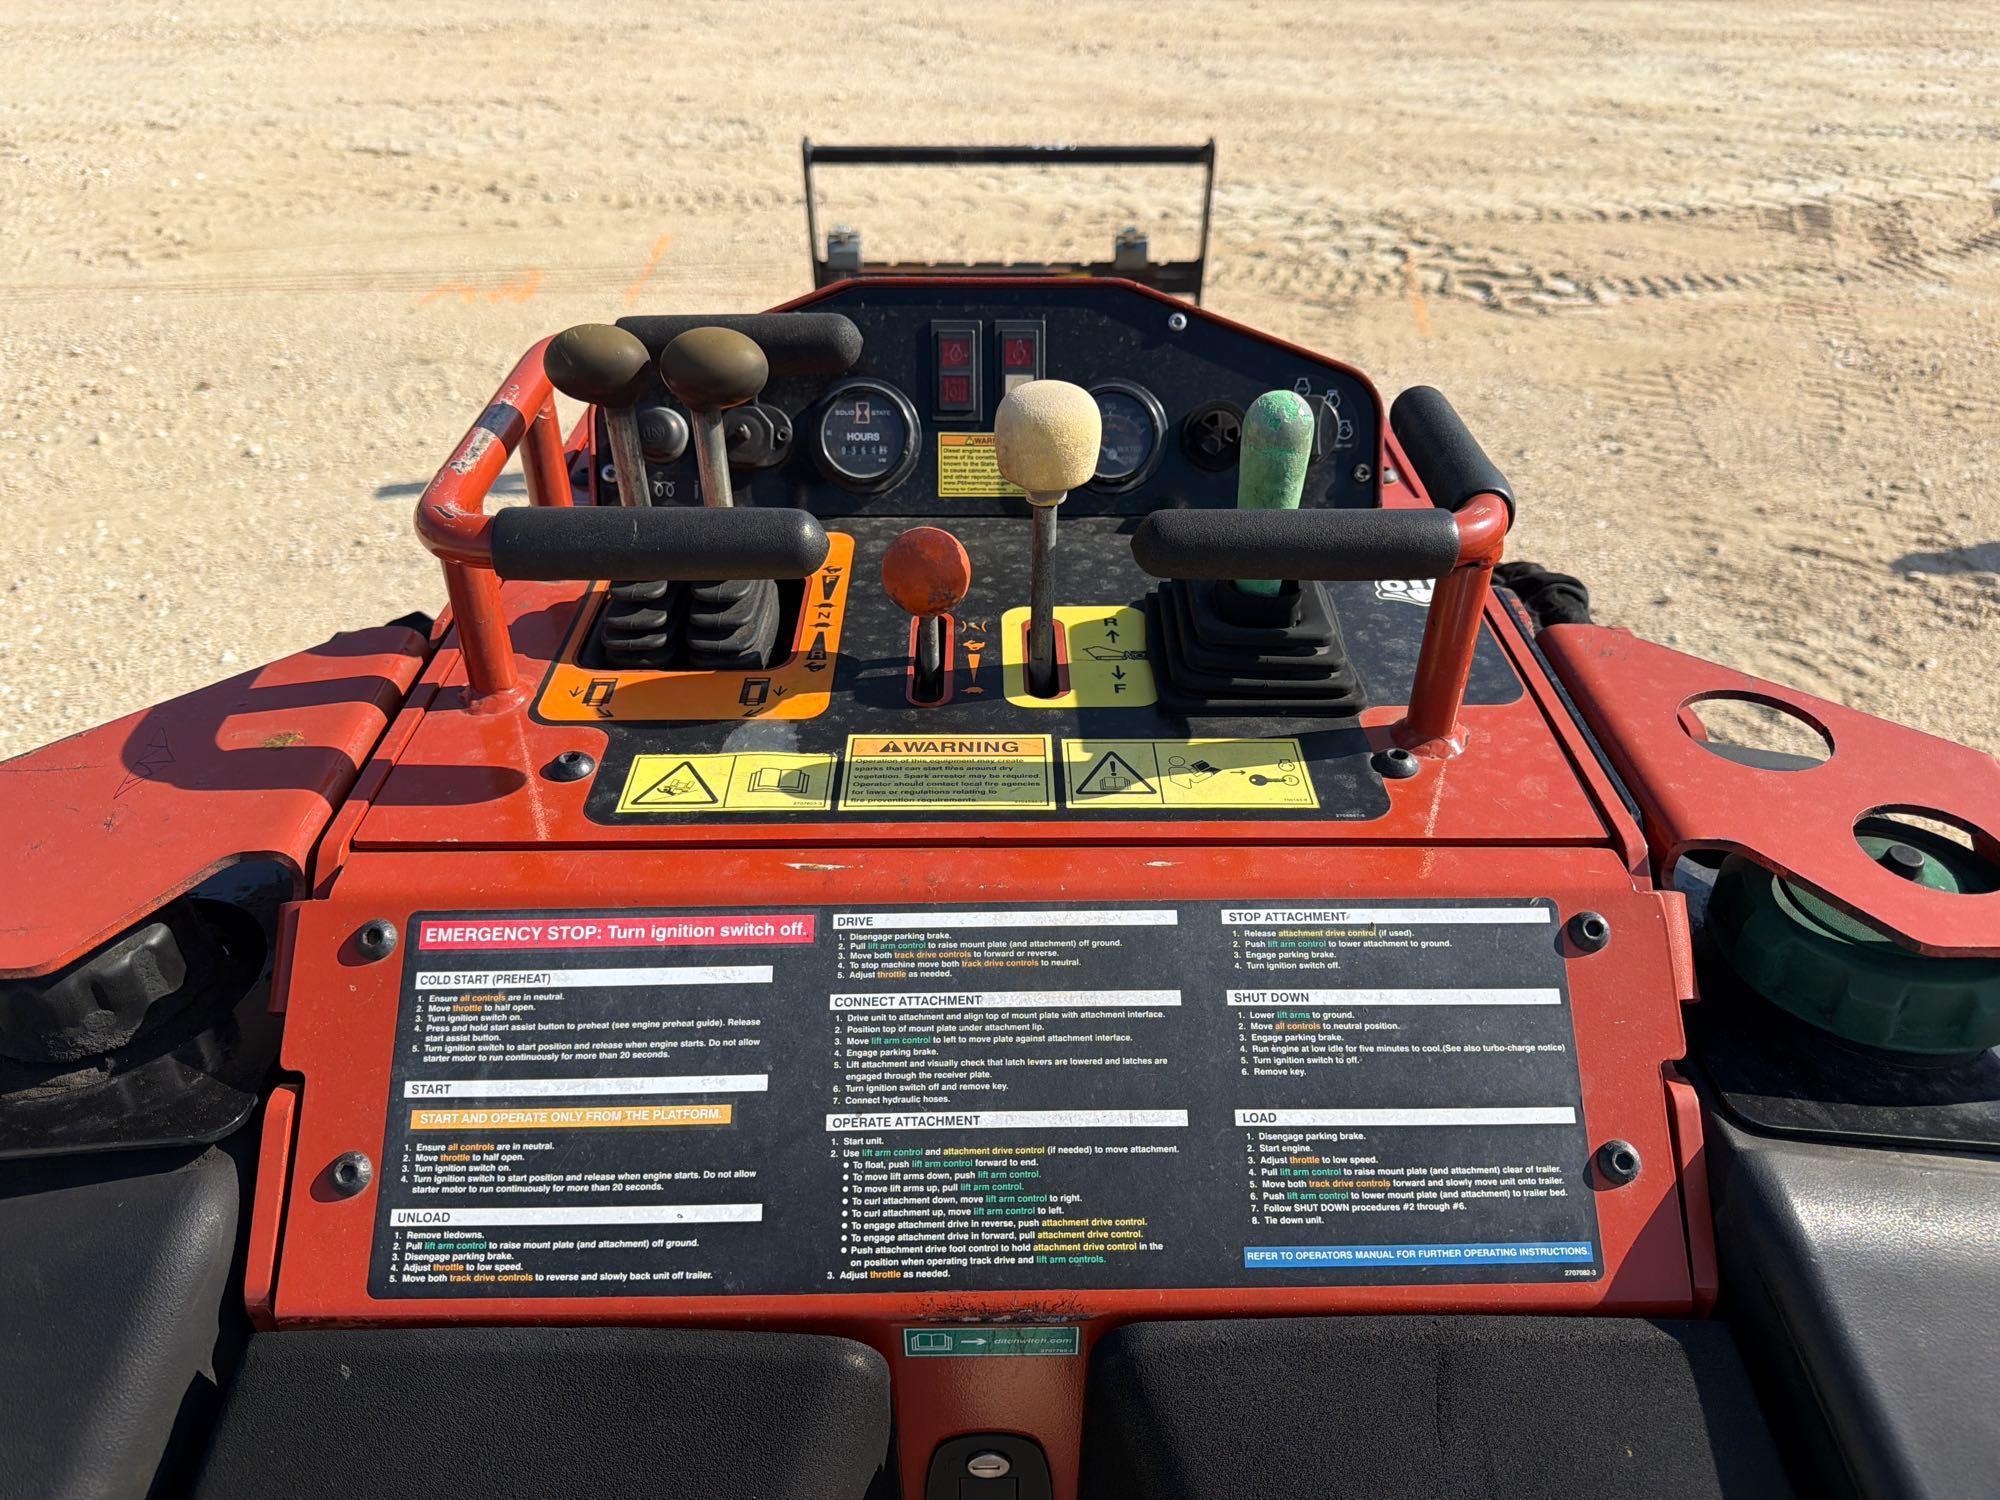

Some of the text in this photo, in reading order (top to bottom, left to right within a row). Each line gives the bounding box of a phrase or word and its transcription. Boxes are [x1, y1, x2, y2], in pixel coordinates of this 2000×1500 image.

[846, 432, 880, 441] HOURS
[1104, 618, 1118, 626] R
[1114, 684, 1127, 693] F
[904, 741, 1019, 753] WARNING
[953, 788, 986, 796] relating
[838, 916, 873, 927] DRIVE
[1229, 912, 1348, 922] STOP ATTACHMENT
[426, 921, 806, 943] EMERGENCY STOP: Turn ignition switch off.
[850, 933, 893, 942] Disengage
[894, 932, 925, 941] parking
[927, 932, 952, 940] brake.
[1278, 929, 1323, 937] attachment
[1325, 929, 1346, 937] drive
[1347, 928, 1376, 937] control
[1378, 929, 1387, 938] (if
[1389, 929, 1414, 938] used).
[420, 973, 551, 986] COLD START (PREHEAT)
[849, 971, 875, 980] Adjust
[877, 970, 906, 978] throttle
[920, 970, 952, 978] needed.
[429, 994, 458, 1003] Ensure
[460, 994, 470, 1002] all
[472, 994, 506, 1002] controls
[523, 993, 532, 1001] in
[533, 993, 565, 1001] neutral.
[834, 995, 982, 1007] CONNECT ATTACHMENT
[1234, 992, 1309, 1003] SHUT DOWN
[1241, 1067, 1306, 1077] 6. Remove key.
[411, 1084, 452, 1095] START
[845, 1096, 880, 1104] Connect
[882, 1095, 921, 1105] hydraulic
[923, 1095, 950, 1103] hoses.
[420, 1108, 721, 1124] START AND OPERATE ONLY FROM THE PLATFORM.
[1242, 1112, 1277, 1123] LOAD
[832, 1115, 980, 1128] OPERATE ATTACHMENT
[832, 1136, 884, 1146] 1. Start unit.
[1247, 1144, 1313, 1154] 2. Start engine.
[852, 1161, 863, 1169] To
[865, 1160, 886, 1170] float,
[888, 1160, 910, 1170] push
[912, 1160, 922, 1168] lift
[943, 1159, 973, 1167] control
[975, 1158, 1008, 1167] forward
[1009, 1158, 1018, 1166] to
[1020, 1158, 1039, 1166] end.
[398, 1212, 450, 1223] UNLOAD
[1252, 1216, 1325, 1224] 8. Tie down unit.
[406, 1230, 442, 1240] Remove
[443, 1230, 484, 1239] tiedowns.
[1247, 1246, 1590, 1260] REFER TO OPERATORS MANUAL FOR FURTHER OPERATING INSTRUCTIONS.
